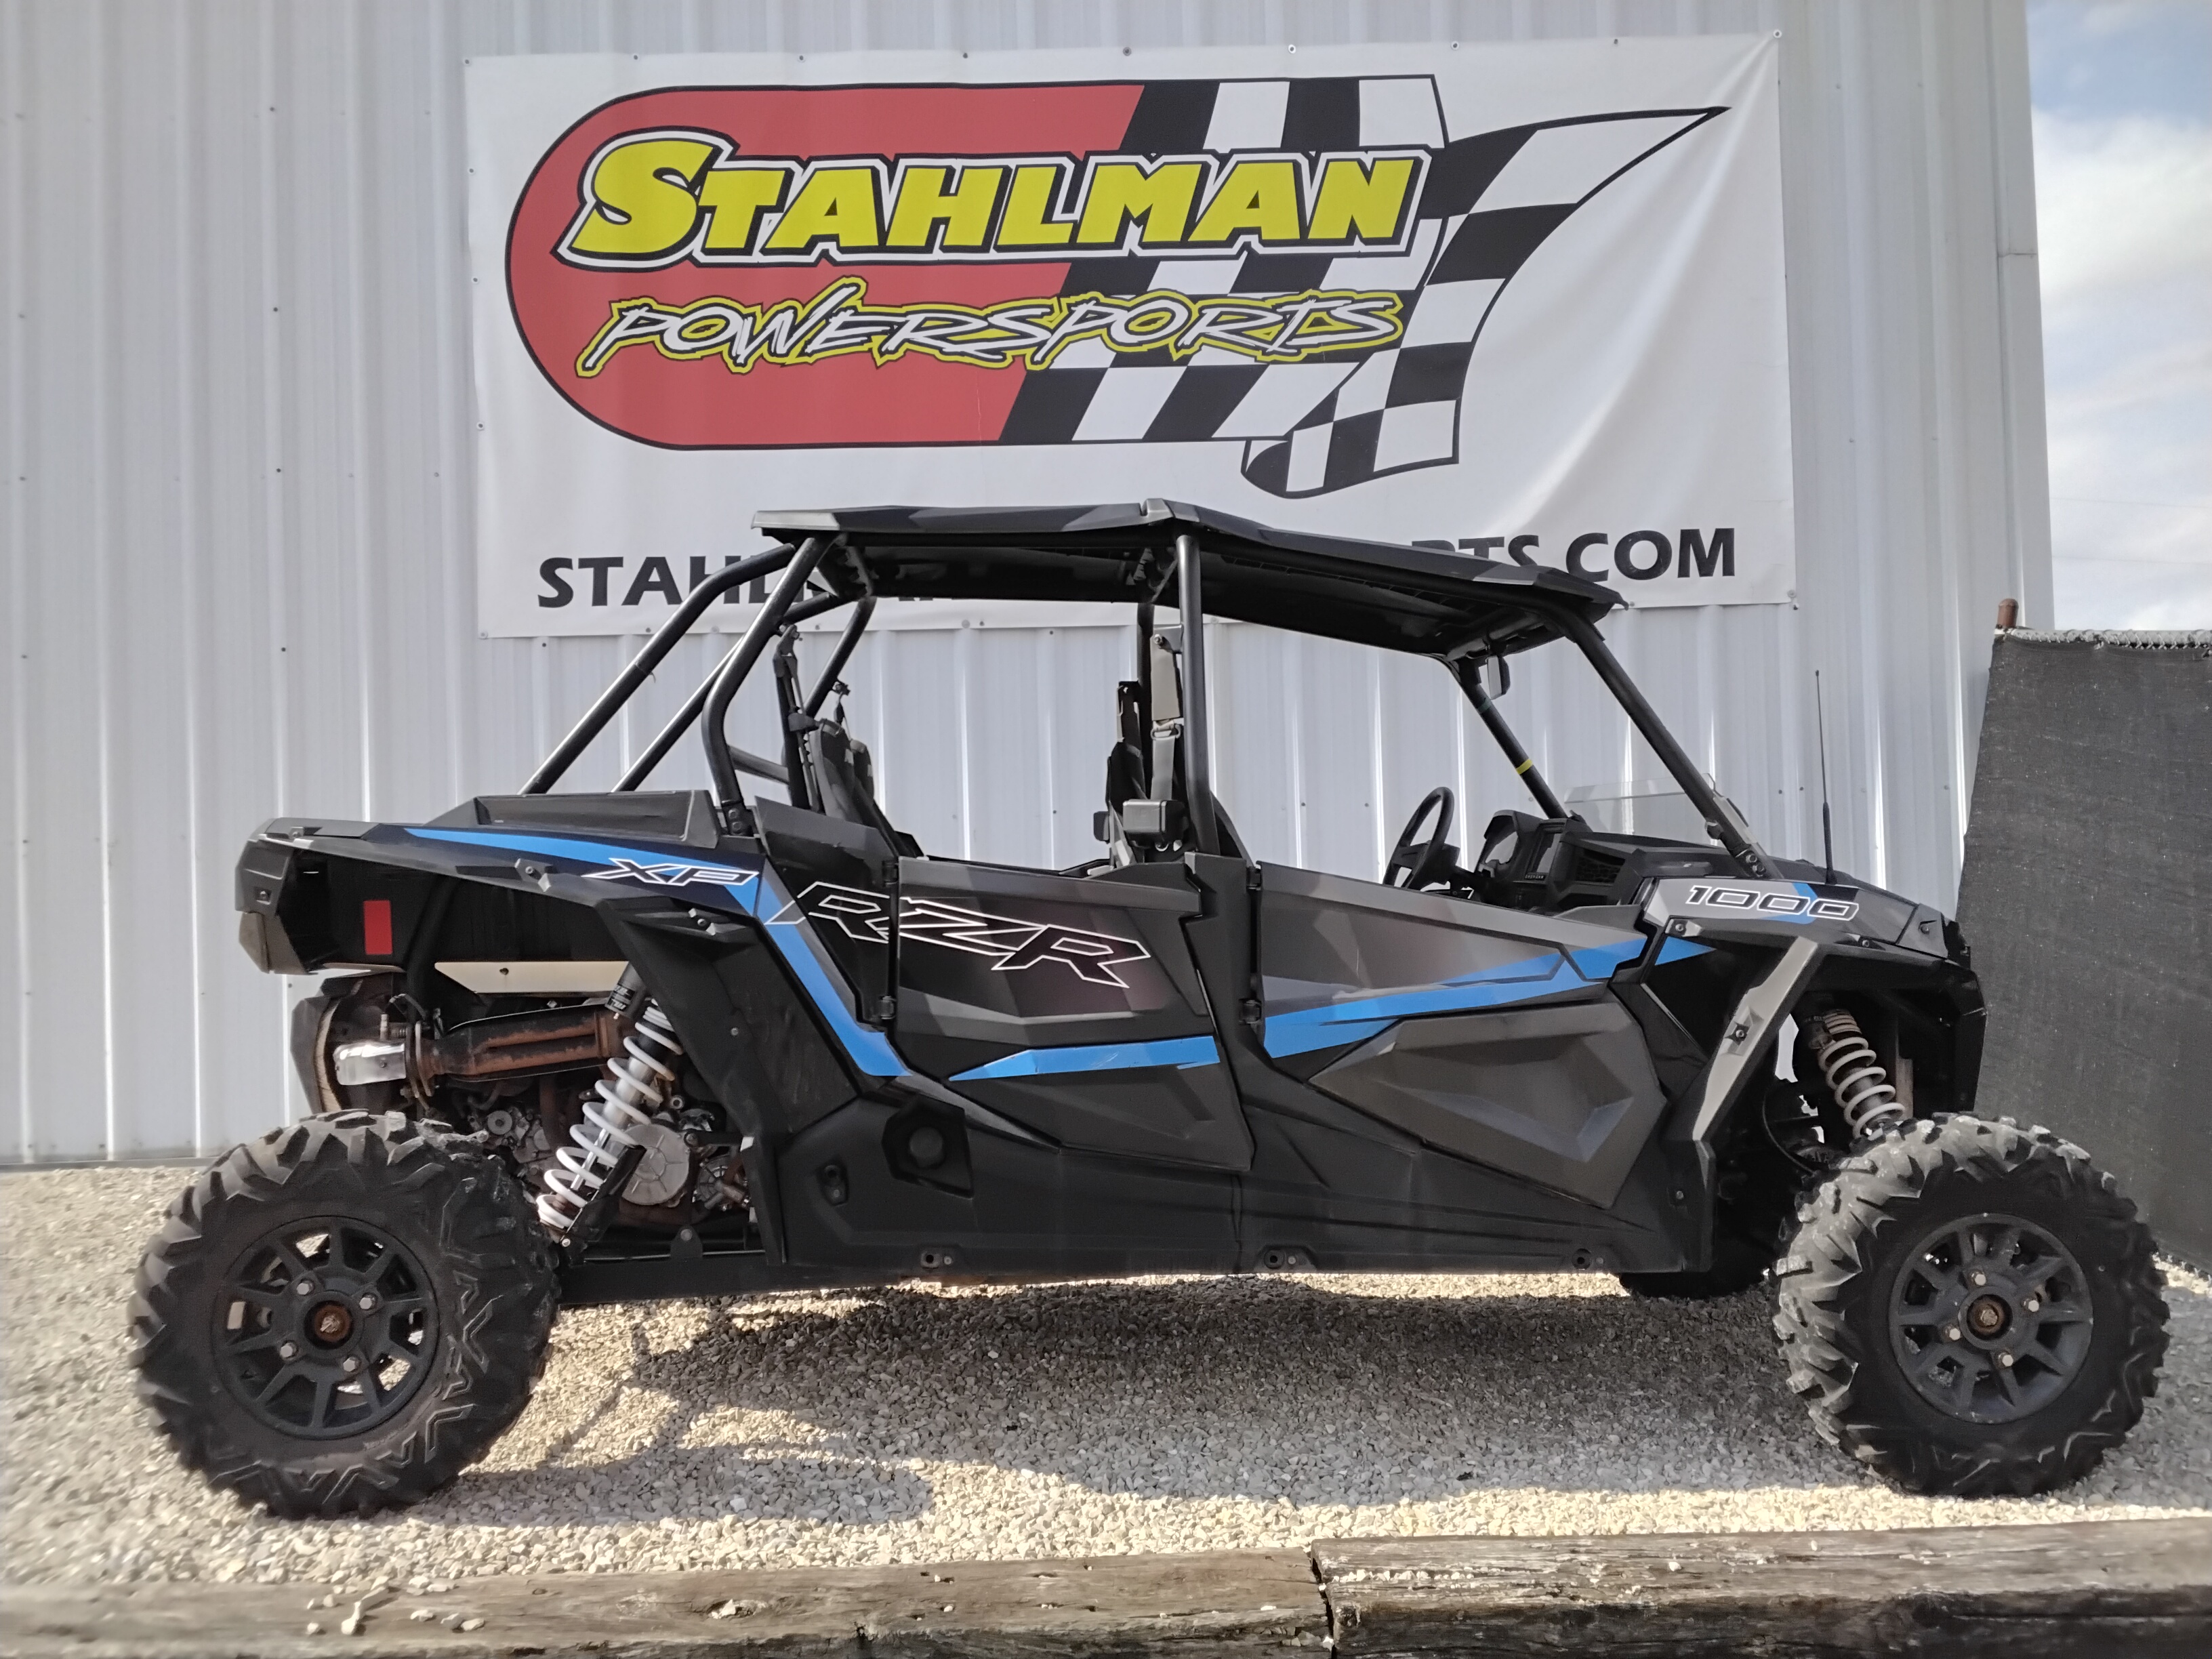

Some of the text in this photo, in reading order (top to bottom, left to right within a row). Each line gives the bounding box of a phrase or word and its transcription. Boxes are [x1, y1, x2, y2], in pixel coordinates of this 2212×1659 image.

[554, 129, 1428, 270] STAHLMAN
[577, 276, 1403, 375] POWERSPORTS
[581, 857, 759, 886] XP
[1685, 884, 1860, 920] 1000
[764, 882, 1151, 988] RZR
